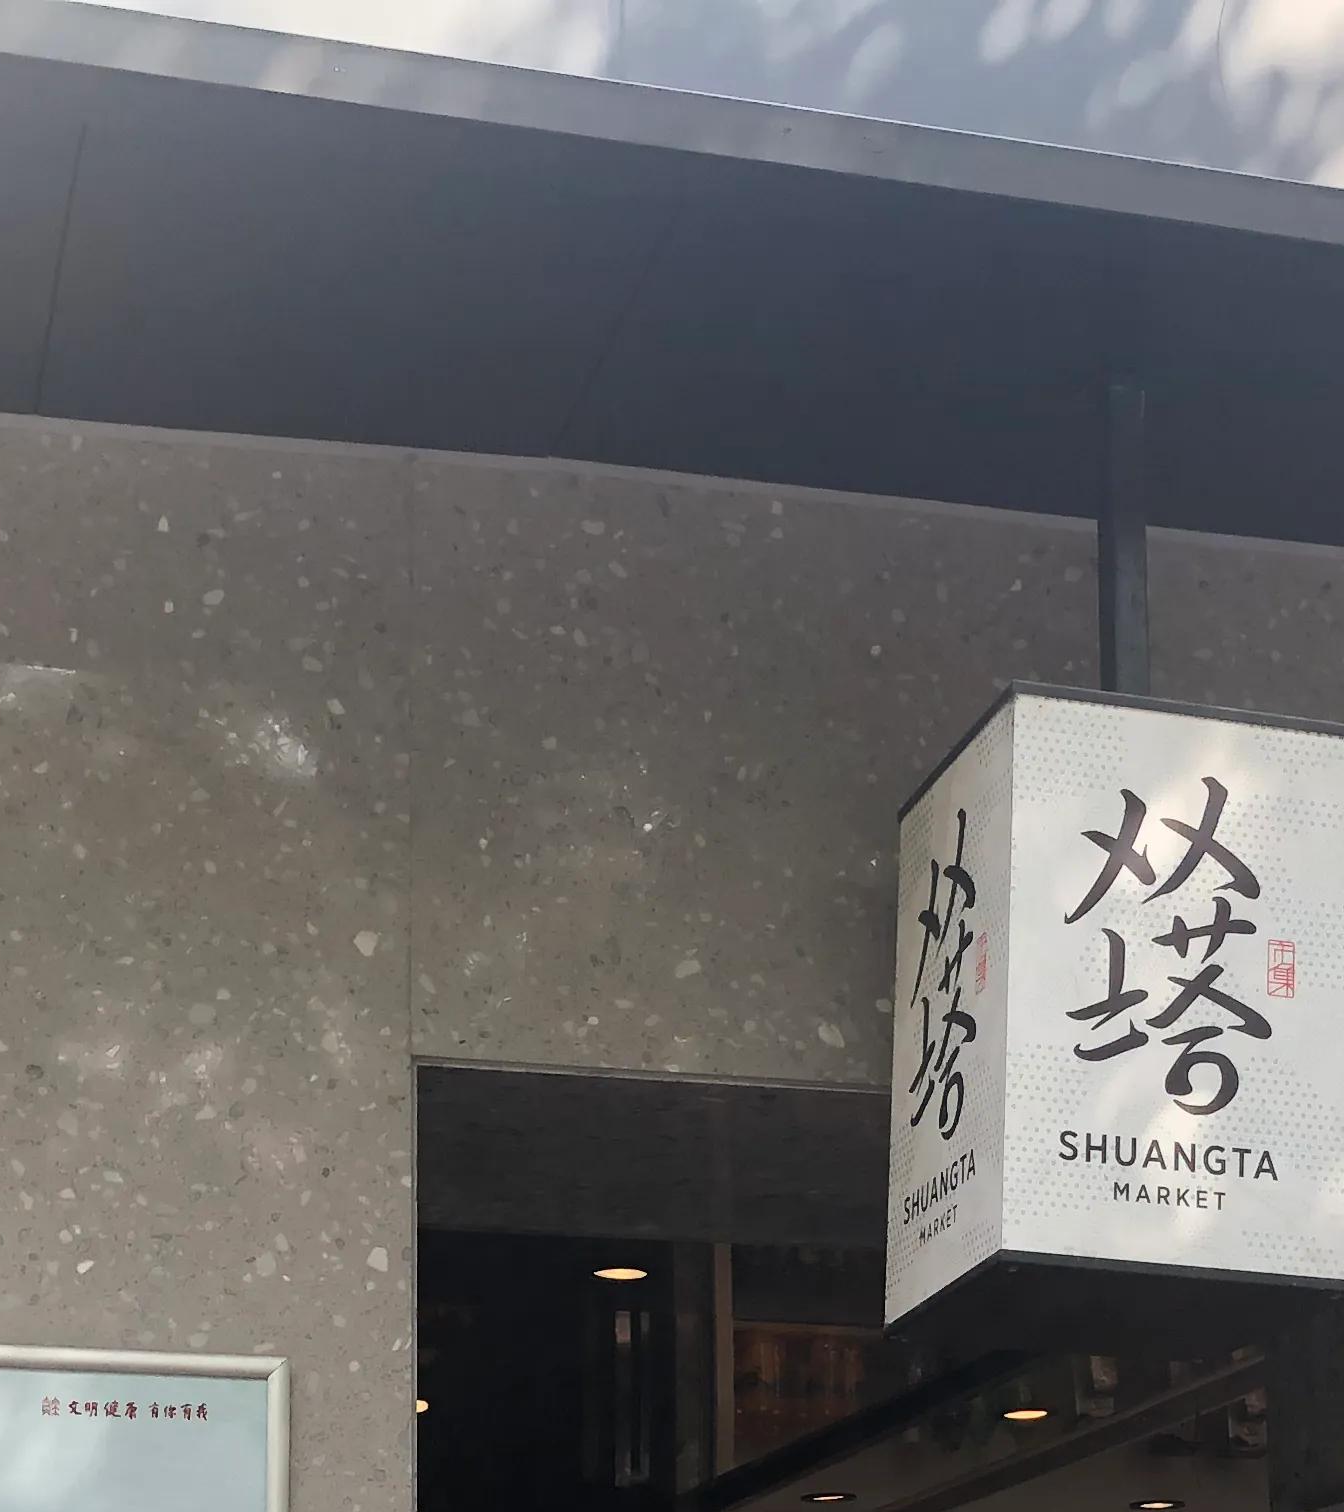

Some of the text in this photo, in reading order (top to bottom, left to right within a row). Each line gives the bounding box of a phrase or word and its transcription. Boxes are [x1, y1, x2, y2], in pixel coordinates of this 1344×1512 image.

[1058, 1129, 1279, 1182] SHUANGTA
[903, 1148, 977, 1226] SHUANGTA
[1112, 1181, 1227, 1212] MARKET
[918, 1204, 959, 1248] MARKET
[68, 1400, 209, 1421] 文明健康 有你有我
